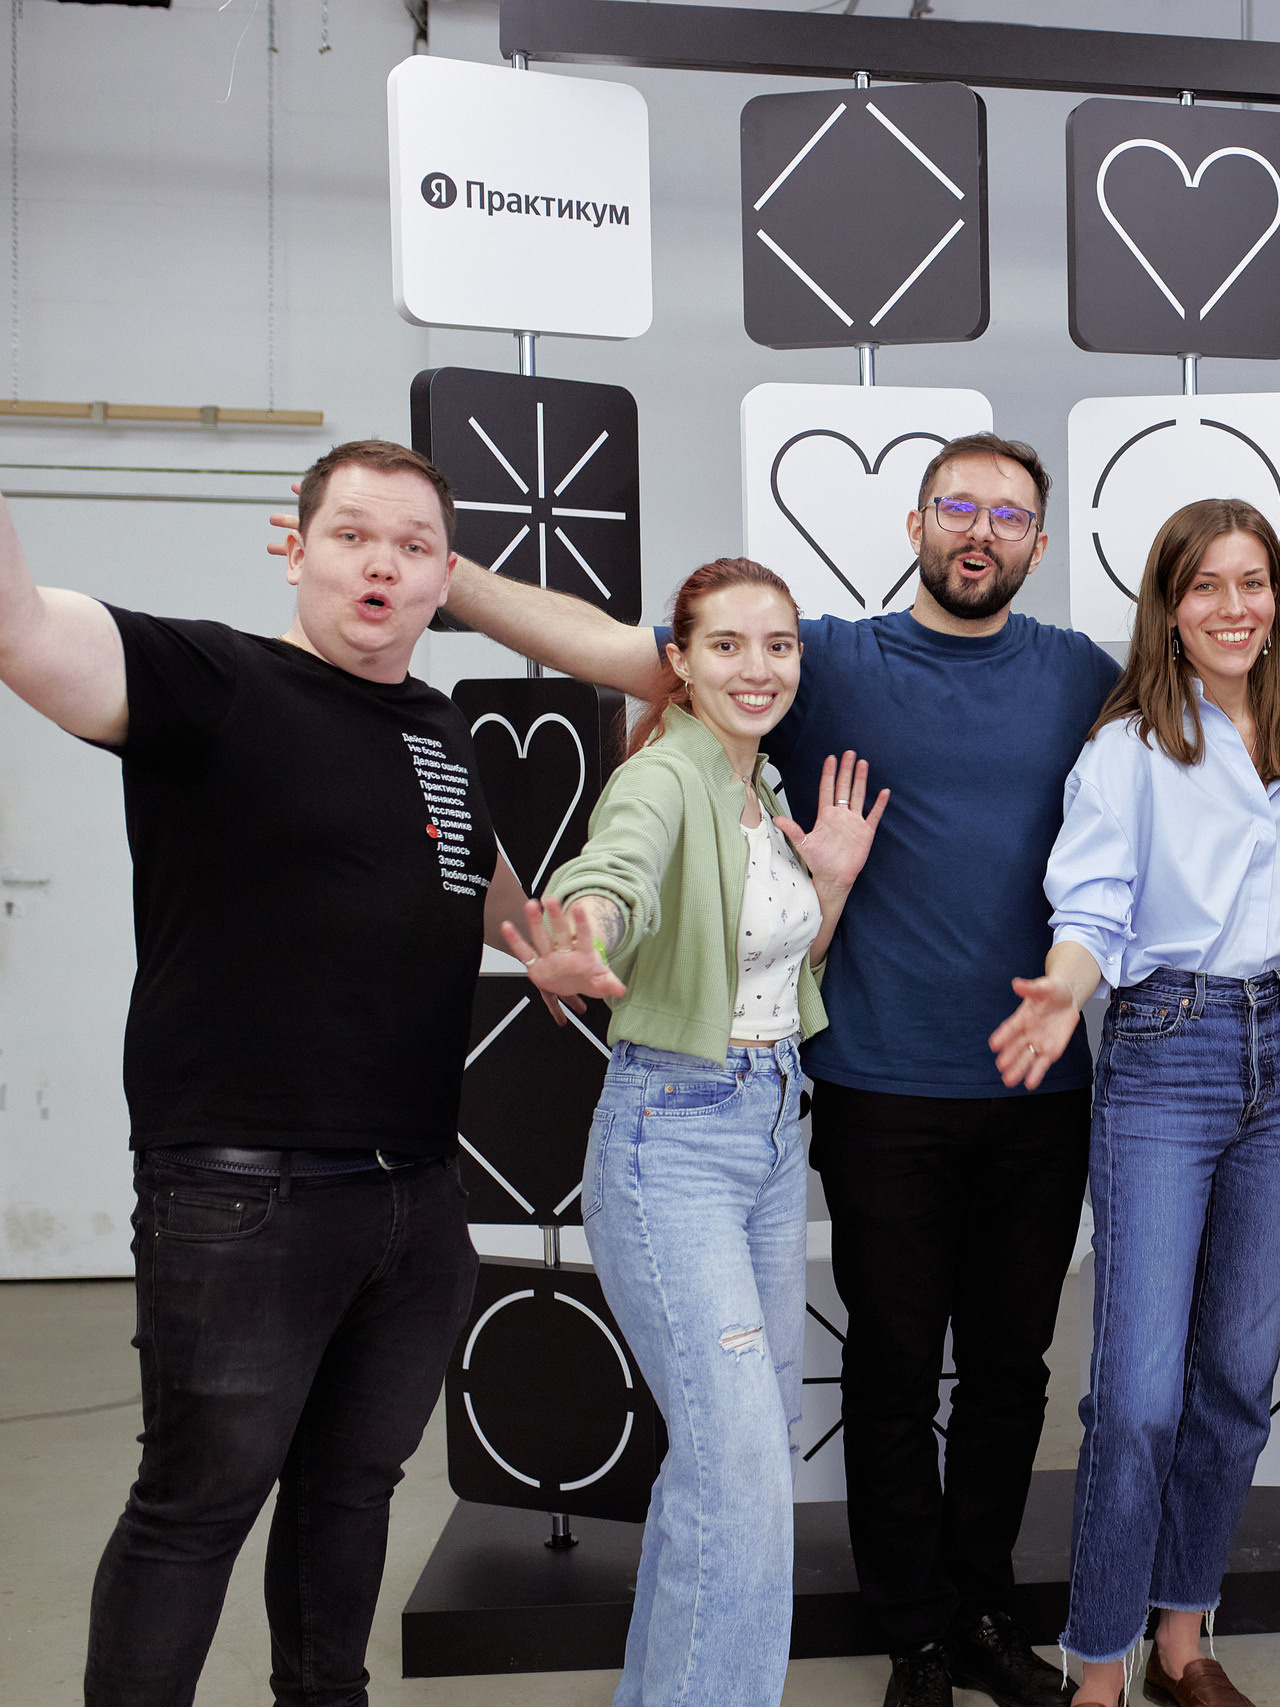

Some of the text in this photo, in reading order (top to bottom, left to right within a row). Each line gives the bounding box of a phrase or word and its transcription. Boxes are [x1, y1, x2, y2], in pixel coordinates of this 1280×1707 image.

[466, 180, 630, 228] Практикум
[402, 732, 442, 748] Действую
[407, 743, 447, 759] Не боюсь
[413, 755, 440, 769] Делаю
[415, 767, 440, 780] Учусь
[419, 779, 466, 796] Практикую
[423, 791, 465, 806] Меняюсь
[427, 804, 472, 820] Исследую
[431, 816, 439, 826] В
[440, 819, 473, 831] домике
[443, 831, 465, 842] теме
[436, 841, 470, 855] Ленюсь
[438, 854, 465, 868] Злюсь
[441, 867, 468, 881] Люблю
